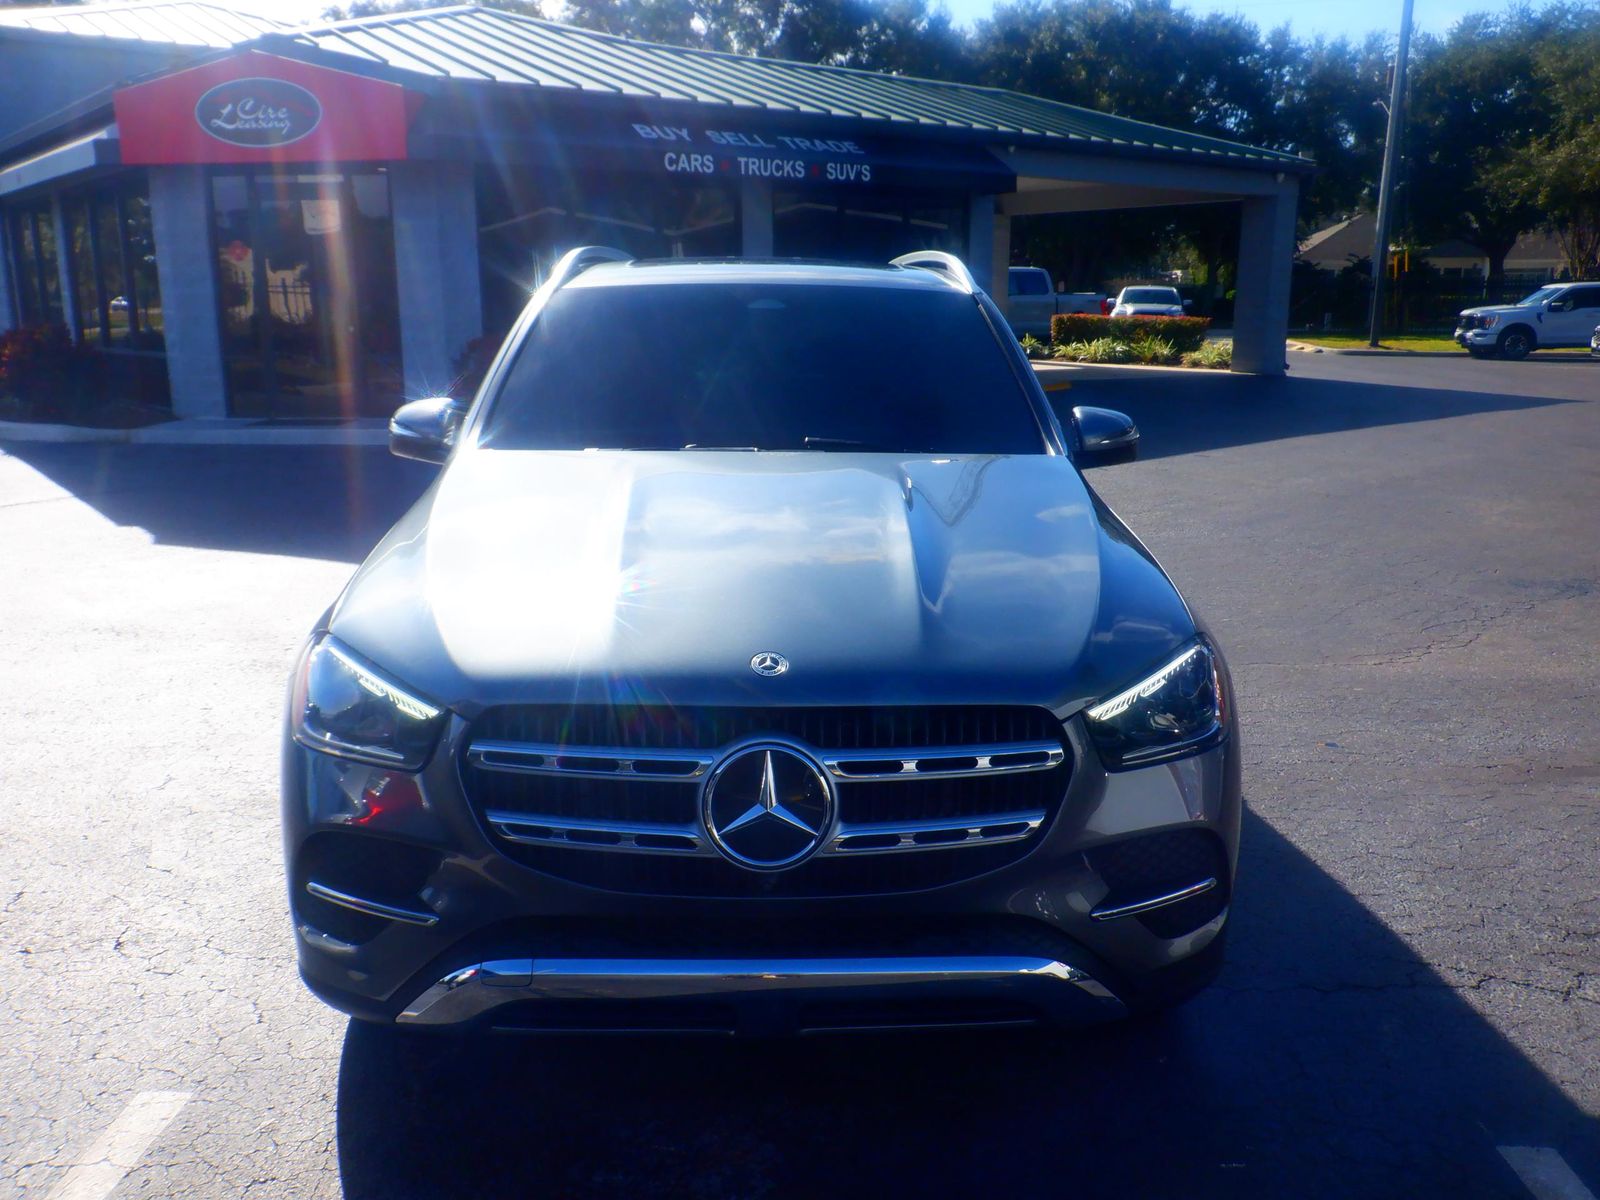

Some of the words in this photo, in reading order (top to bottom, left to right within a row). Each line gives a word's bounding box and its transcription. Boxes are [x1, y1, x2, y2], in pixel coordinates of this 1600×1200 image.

[632, 123, 692, 142] BUY
[705, 130, 776, 149] SELL
[777, 136, 865, 154] TRADE
[664, 152, 714, 173] CARS
[737, 157, 805, 178] TRUCKS
[826, 162, 871, 182] SUV'S
